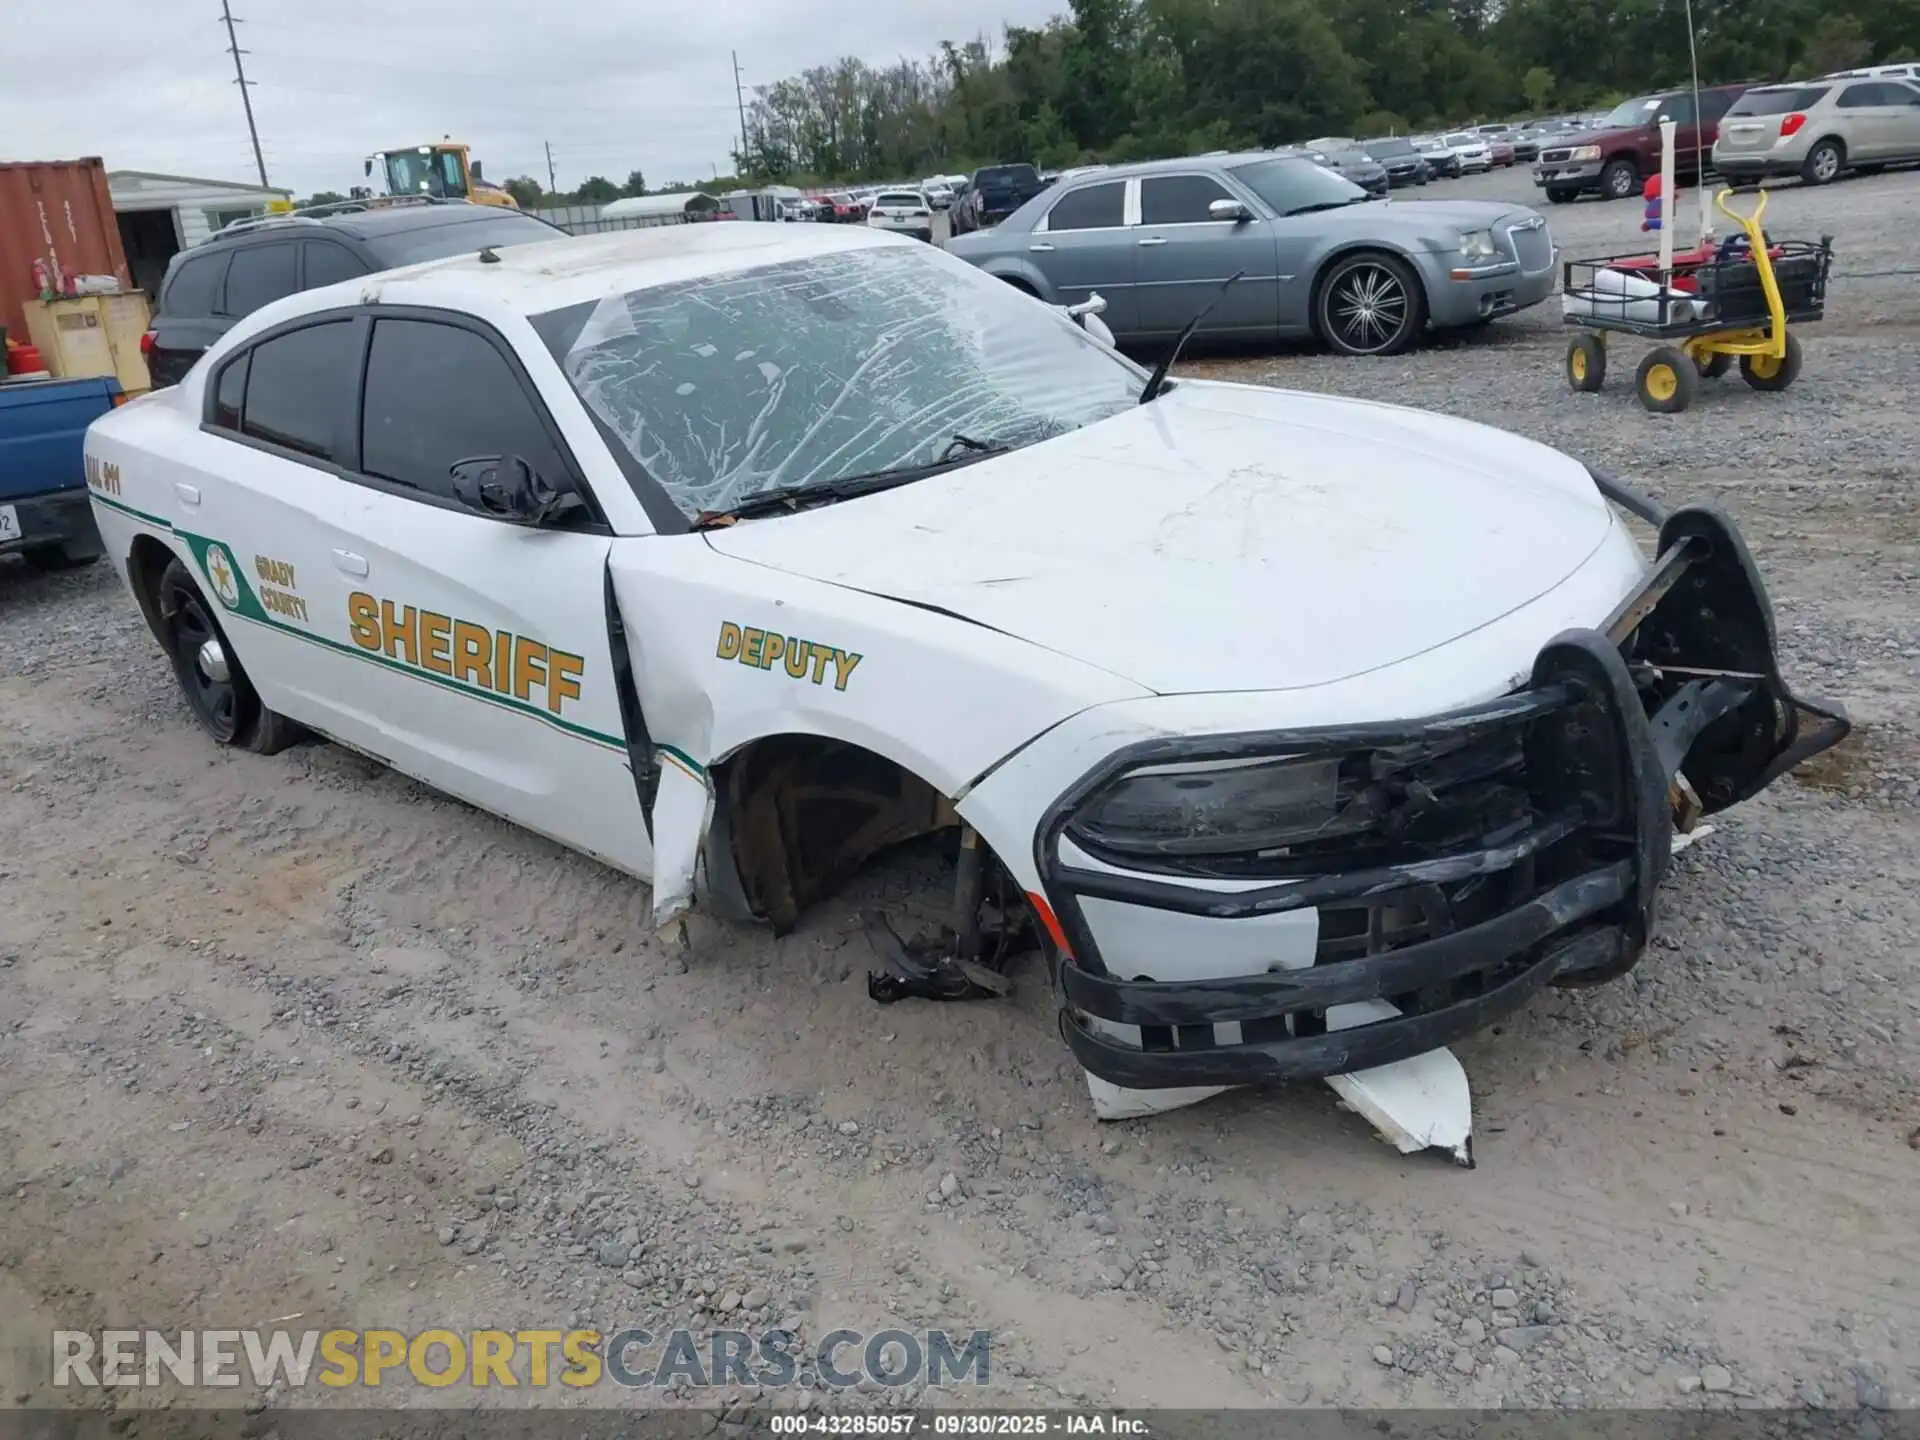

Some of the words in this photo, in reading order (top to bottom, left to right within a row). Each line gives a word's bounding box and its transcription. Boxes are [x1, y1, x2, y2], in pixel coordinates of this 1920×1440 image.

[259, 585, 308, 622] COUNTY
[348, 591, 584, 715] SHERIFF
[716, 620, 864, 692] DEPUTY
